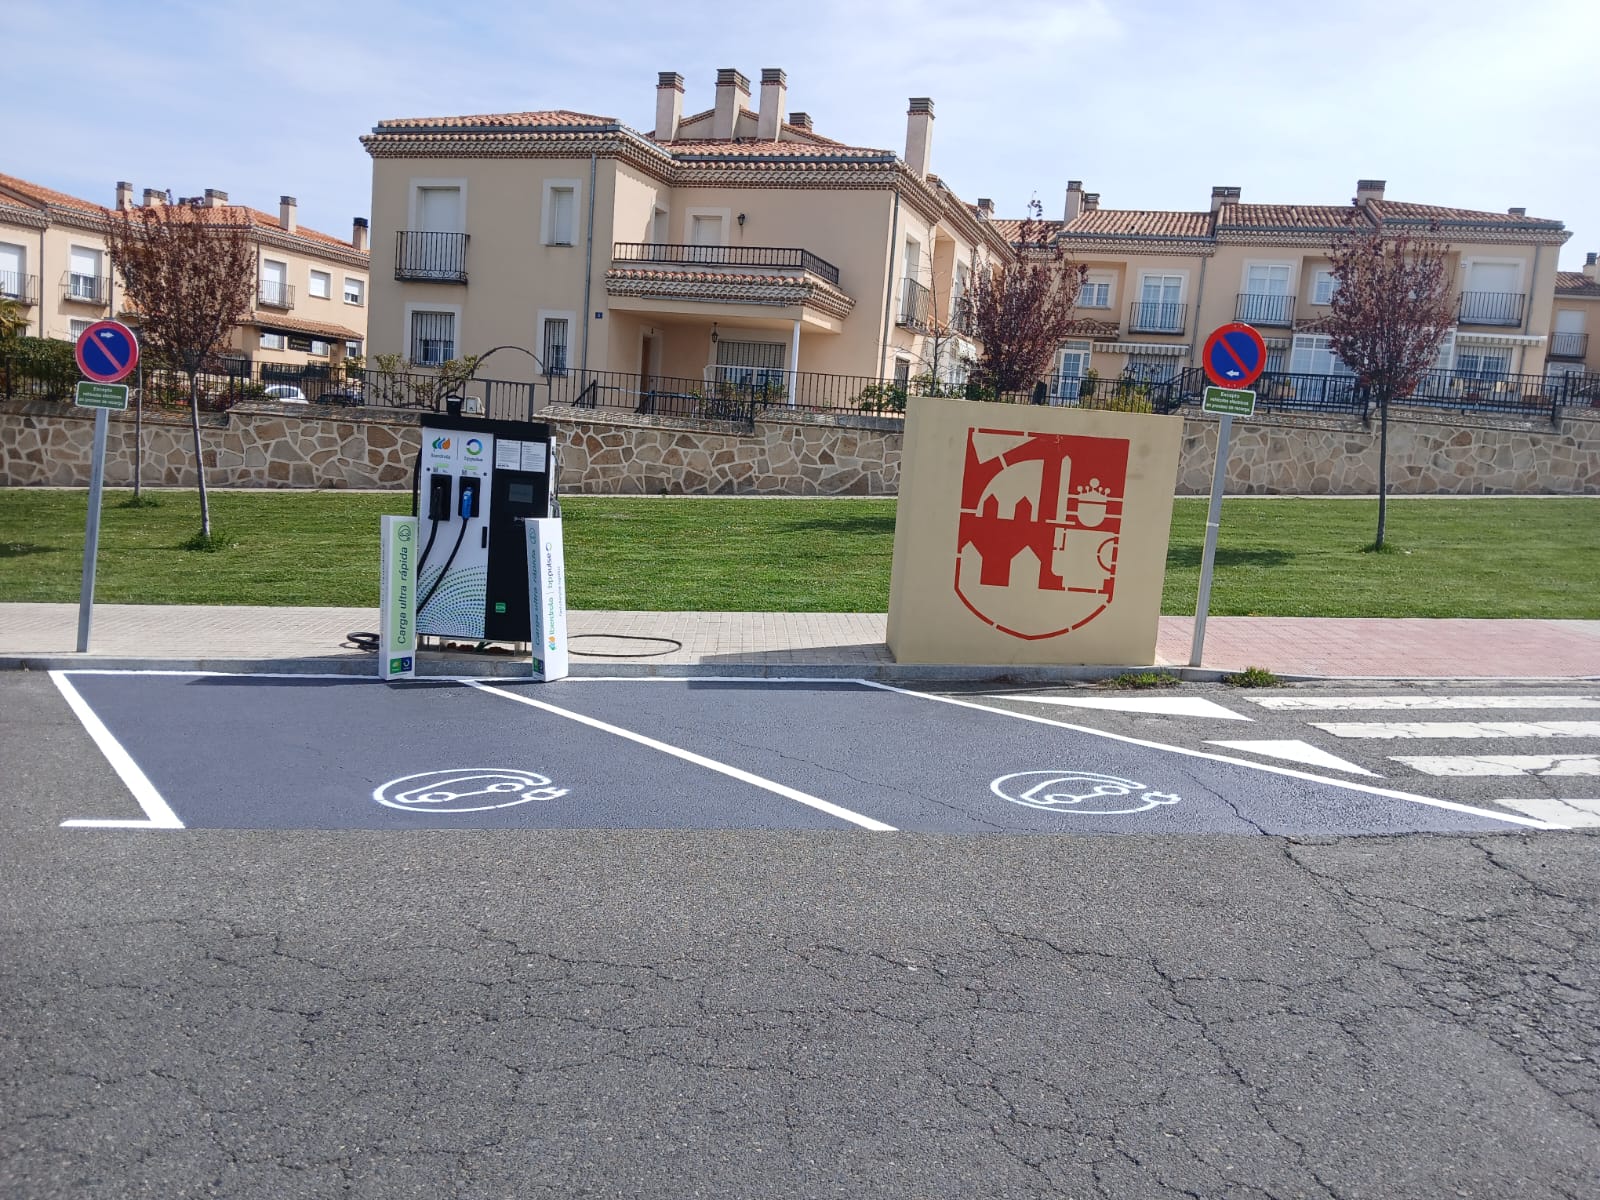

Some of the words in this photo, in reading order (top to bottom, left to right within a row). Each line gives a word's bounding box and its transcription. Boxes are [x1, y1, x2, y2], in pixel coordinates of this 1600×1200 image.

[399, 547, 409, 581] rápida
[398, 585, 407, 609] ultra
[397, 612, 408, 644] Carga
